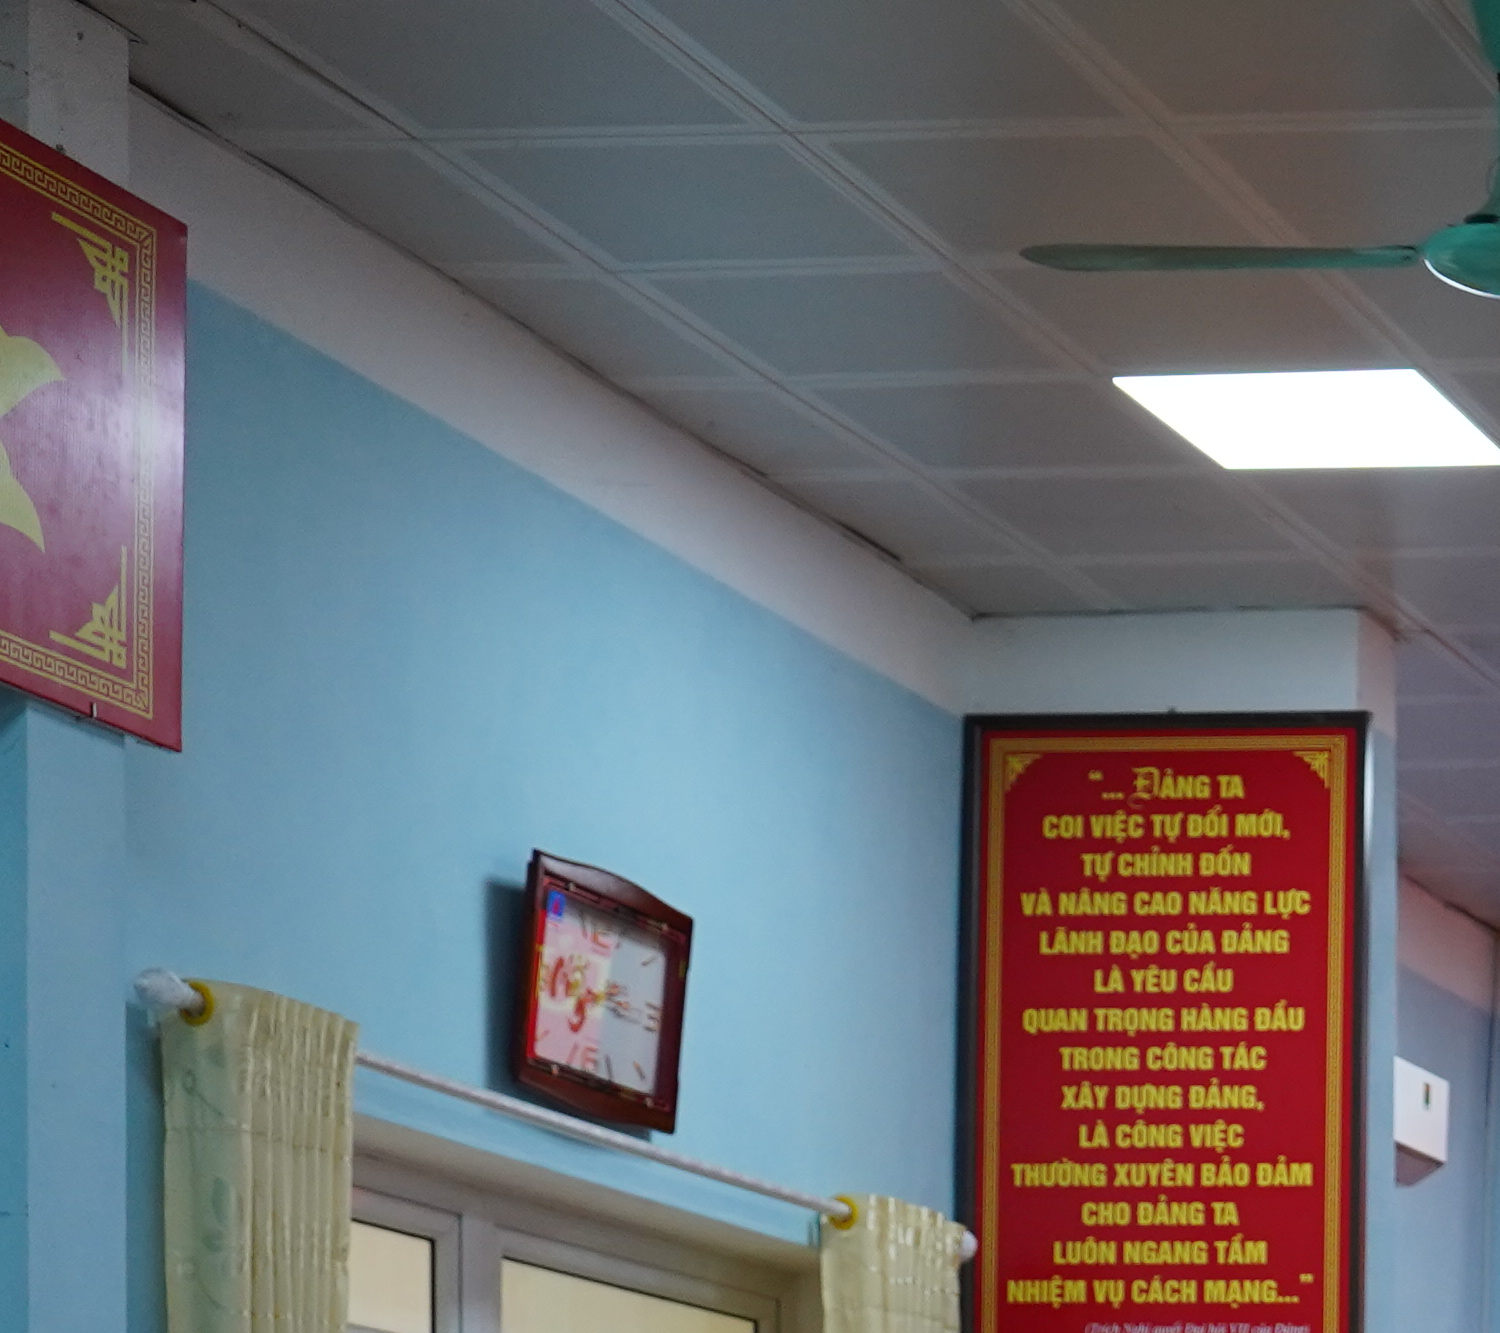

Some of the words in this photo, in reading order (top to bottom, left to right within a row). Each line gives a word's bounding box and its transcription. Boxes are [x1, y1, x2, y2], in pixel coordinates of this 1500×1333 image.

[1134, 767, 1210, 799] ĐẢNG
[1218, 775, 1244, 798] TA
[1043, 815, 1083, 838] COI
[1090, 811, 1144, 843] VIỆC
[1151, 813, 1183, 842] TỰ
[1187, 805, 1228, 837] ĐỔI
[1235, 809, 1290, 838] MỚI,
[1082, 852, 1114, 881] TỰ
[1118, 846, 1193, 876] CHỈNH
[1199, 845, 1251, 876] ĐỐN
[1021, 889, 1052, 915] VÀ
[1059, 888, 1127, 915] NÂNG
[1134, 892, 1182, 915] CAO
[1189, 887, 1258, 915] NĂNG
[1264, 888, 1311, 919] LỰC
[1040, 927, 1103, 954] LÃNH
[1109, 930, 1159, 959] ĐẠO
[1166, 923, 1216, 954] CỦA
[1221, 922, 1289, 954] ĐẢNG
[1094, 965, 1124, 993] LÀ
[1131, 965, 1177, 993] YÊU
[1183, 962, 1233, 993] CẦU
[1011, 1158, 1107, 1187] THƯỜNG
[1114, 1158, 1194, 1187] XUYÊN
[1201, 1155, 1250, 1187] BẢO
[1256, 1155, 1313, 1187] ĐẢM
[1008, 1275, 1086, 1307] NHIỆM
[1093, 1280, 1124, 1308] VỤ
[1131, 1276, 1197, 1303] CÁCH
